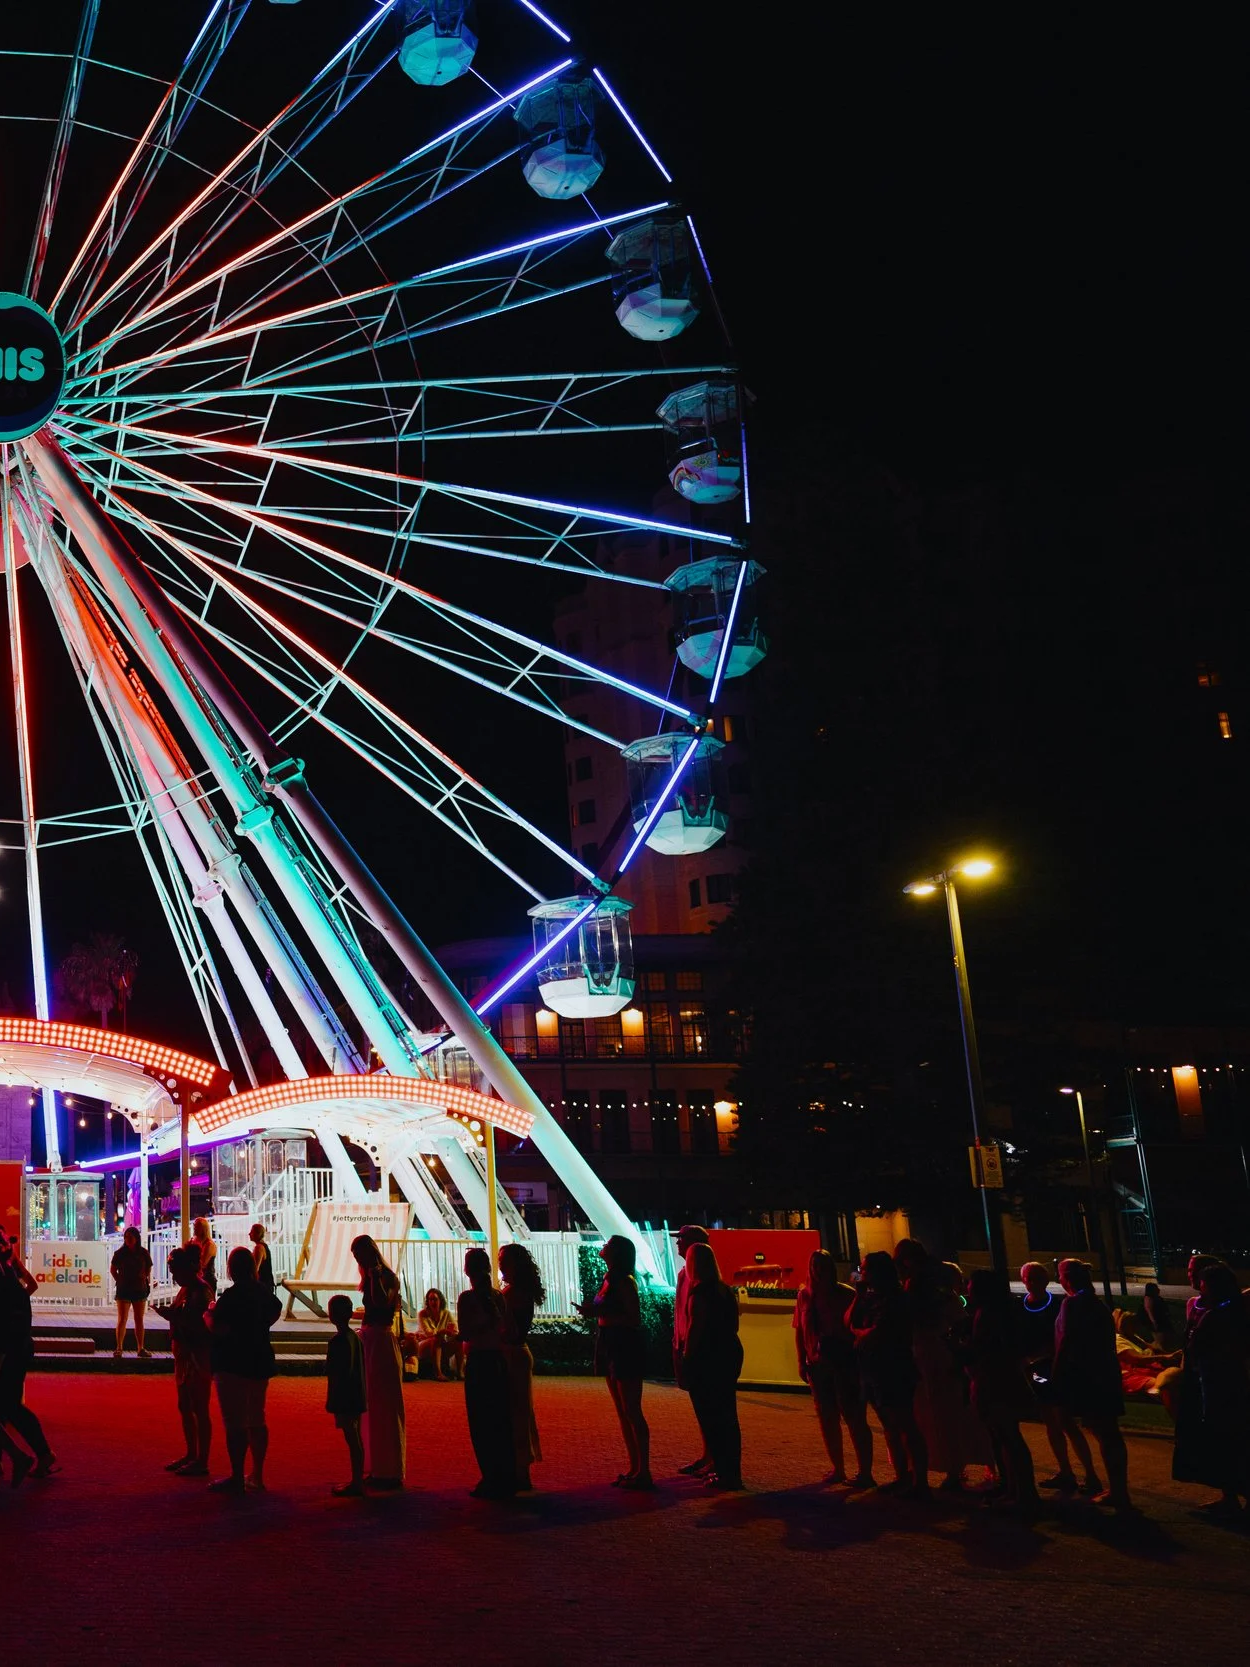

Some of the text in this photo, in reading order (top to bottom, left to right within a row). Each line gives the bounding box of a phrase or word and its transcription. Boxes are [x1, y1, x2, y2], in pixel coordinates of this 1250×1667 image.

[332, 1215, 391, 1223] #jettyrdglenelg
[43, 1253, 88, 1268] kids in
[36, 1268, 101, 1284] adelaide
